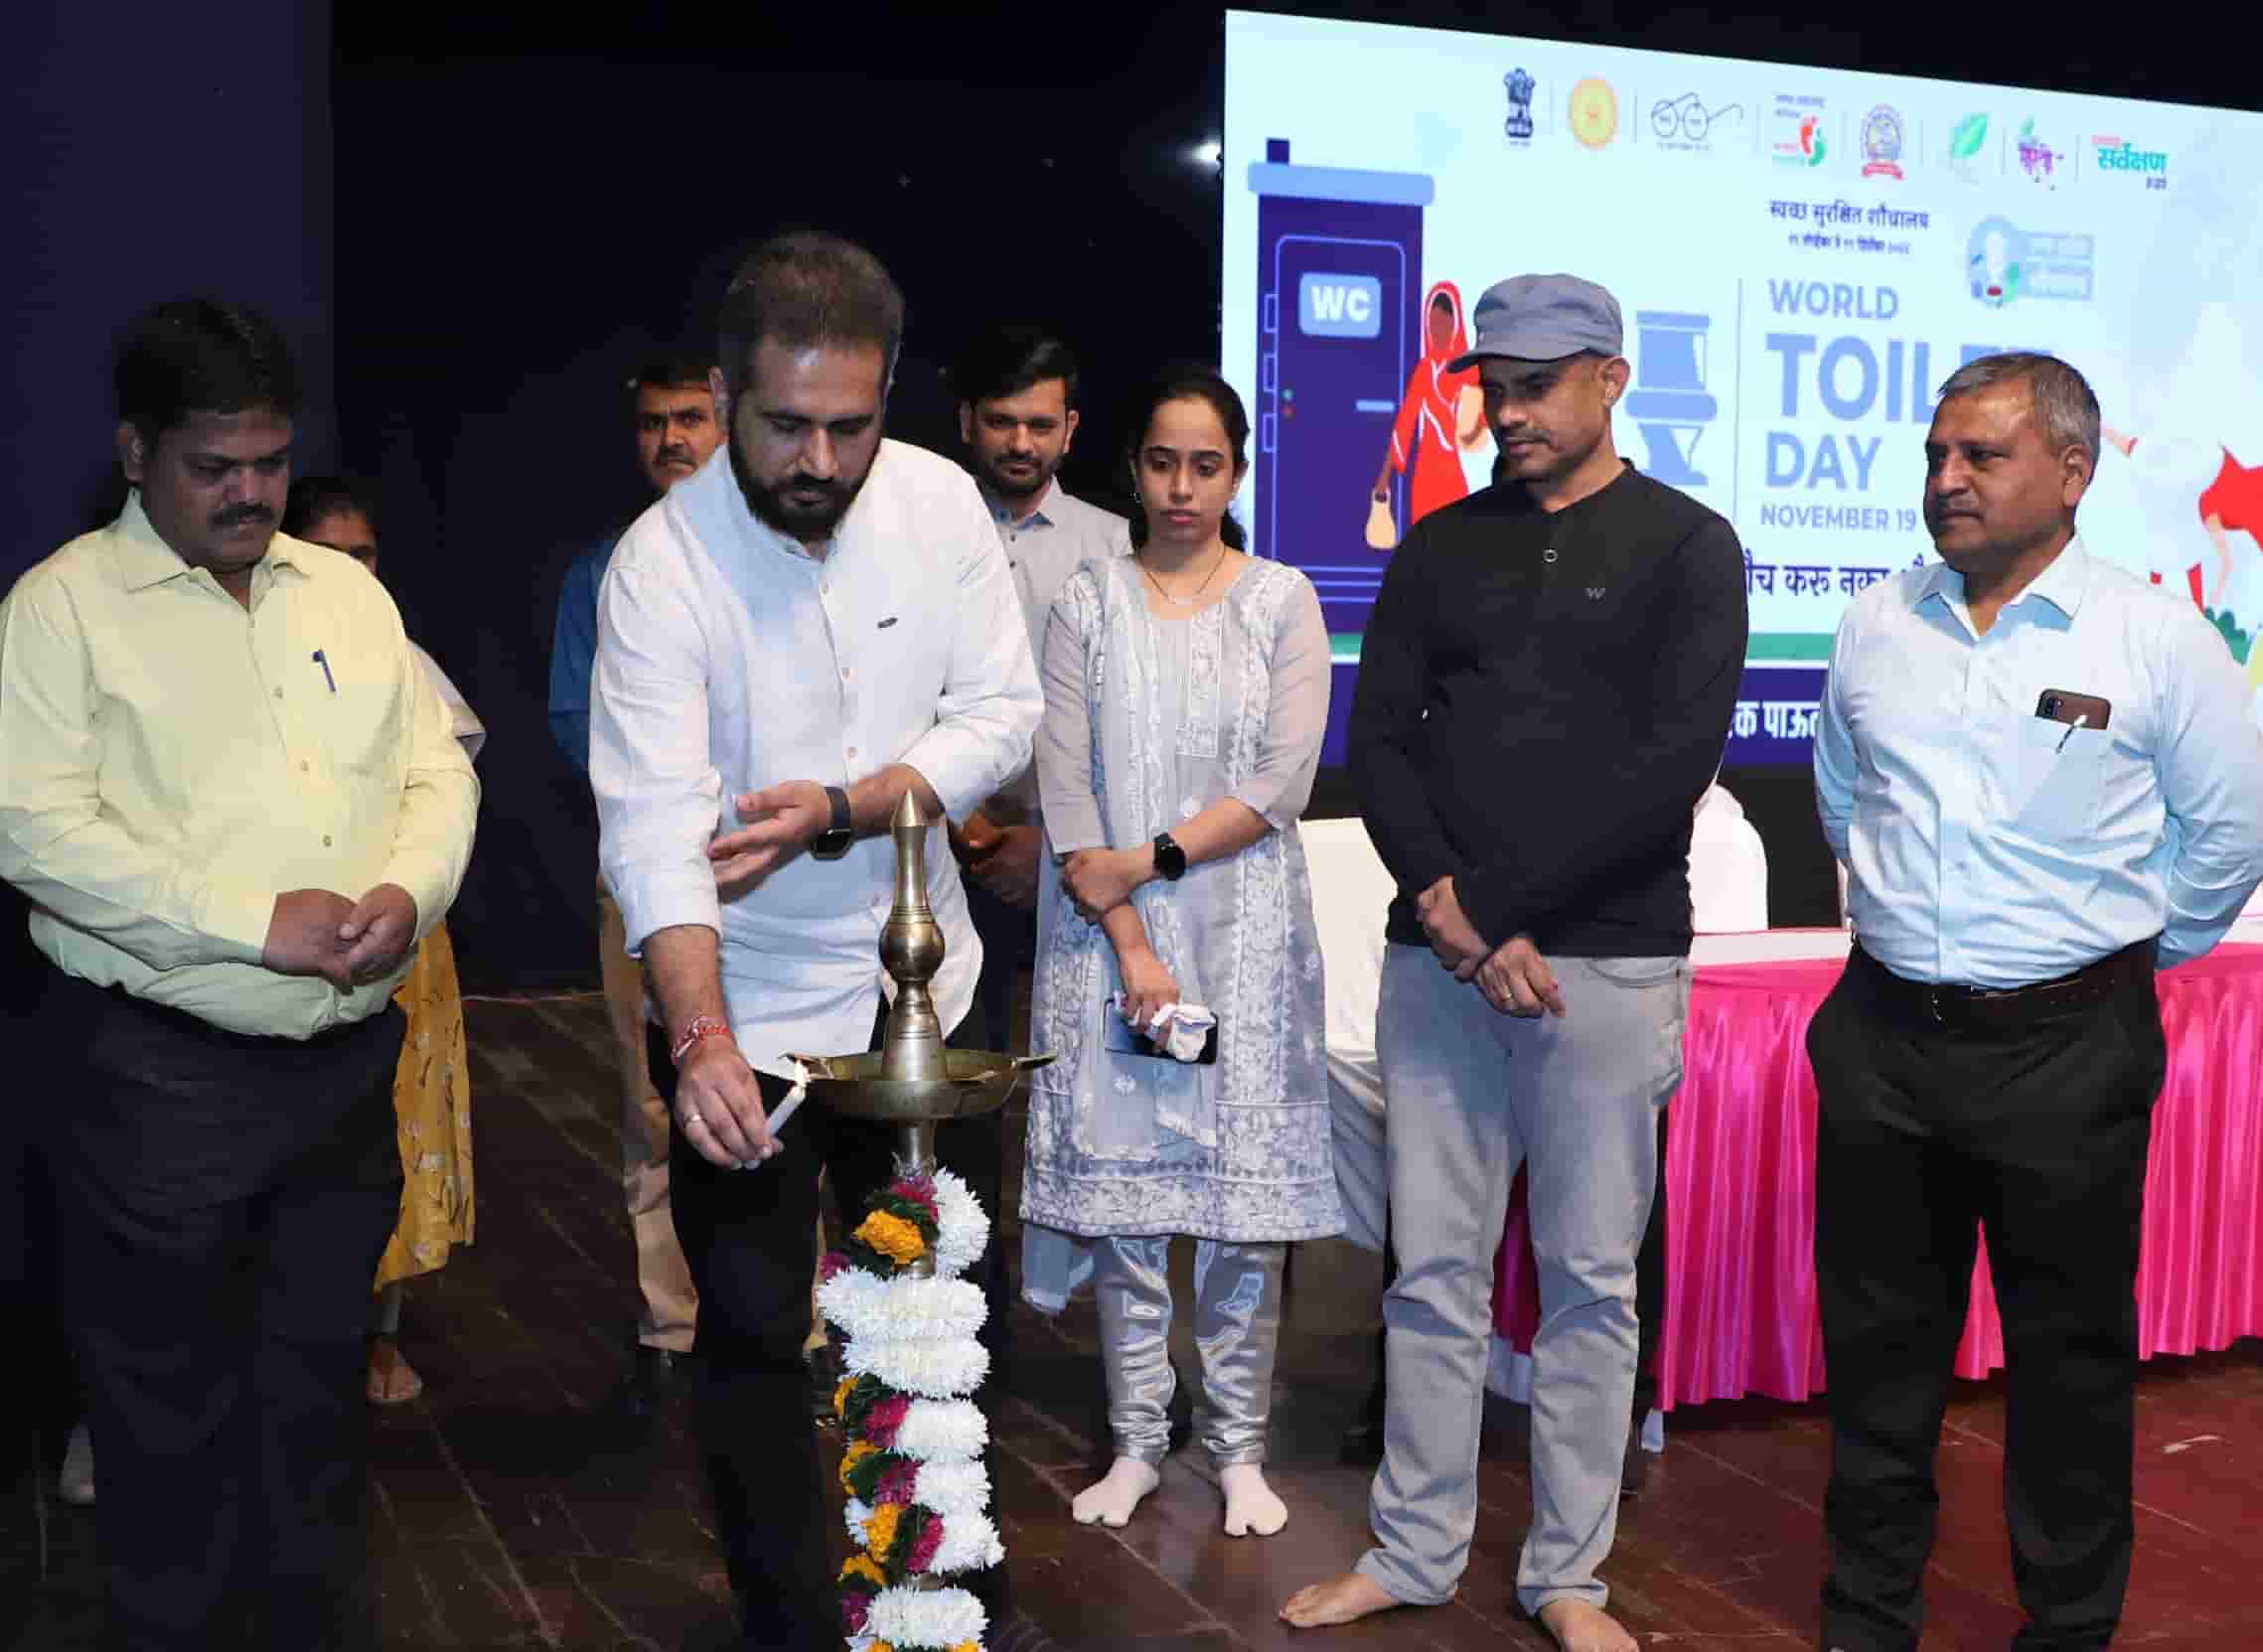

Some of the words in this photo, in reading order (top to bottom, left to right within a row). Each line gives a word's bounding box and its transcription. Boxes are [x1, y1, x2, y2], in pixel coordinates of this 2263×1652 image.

[1310, 284, 1372, 323] WC
[1768, 278, 1899, 320] WORLD
[1765, 430, 1883, 492] DAY
[1759, 503, 1889, 531] NOVEMBER
[1895, 508, 1918, 532] 19
